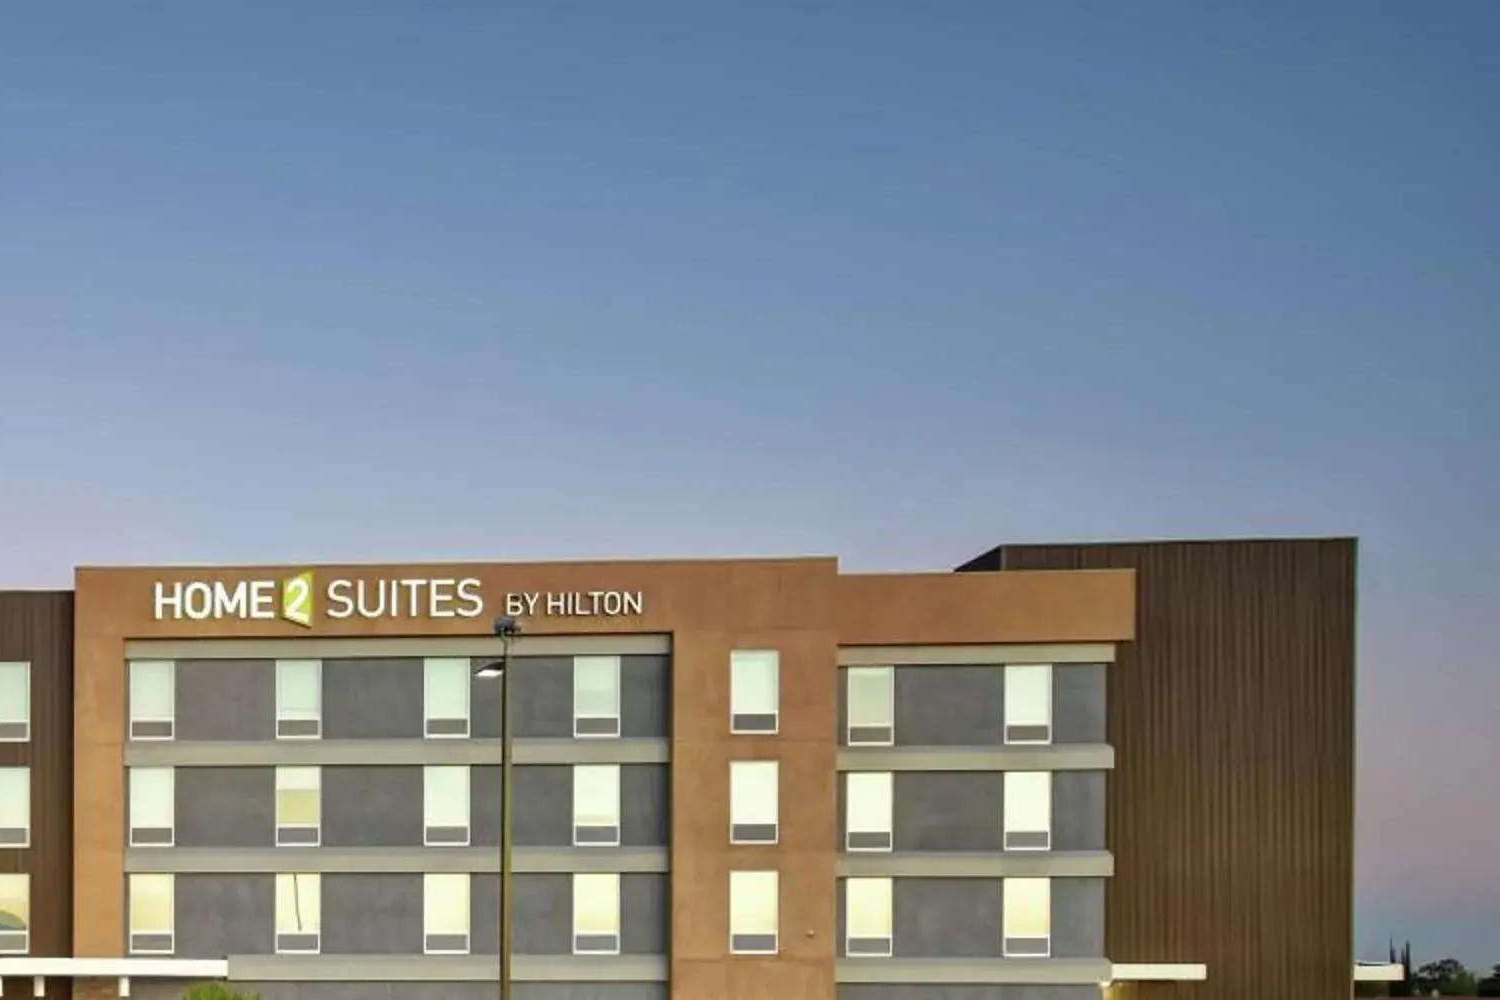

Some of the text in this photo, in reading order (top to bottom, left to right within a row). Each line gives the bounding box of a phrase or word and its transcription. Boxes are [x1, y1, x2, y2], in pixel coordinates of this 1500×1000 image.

[155, 577, 643, 624] HOME 2 SUITES BY HILTON
